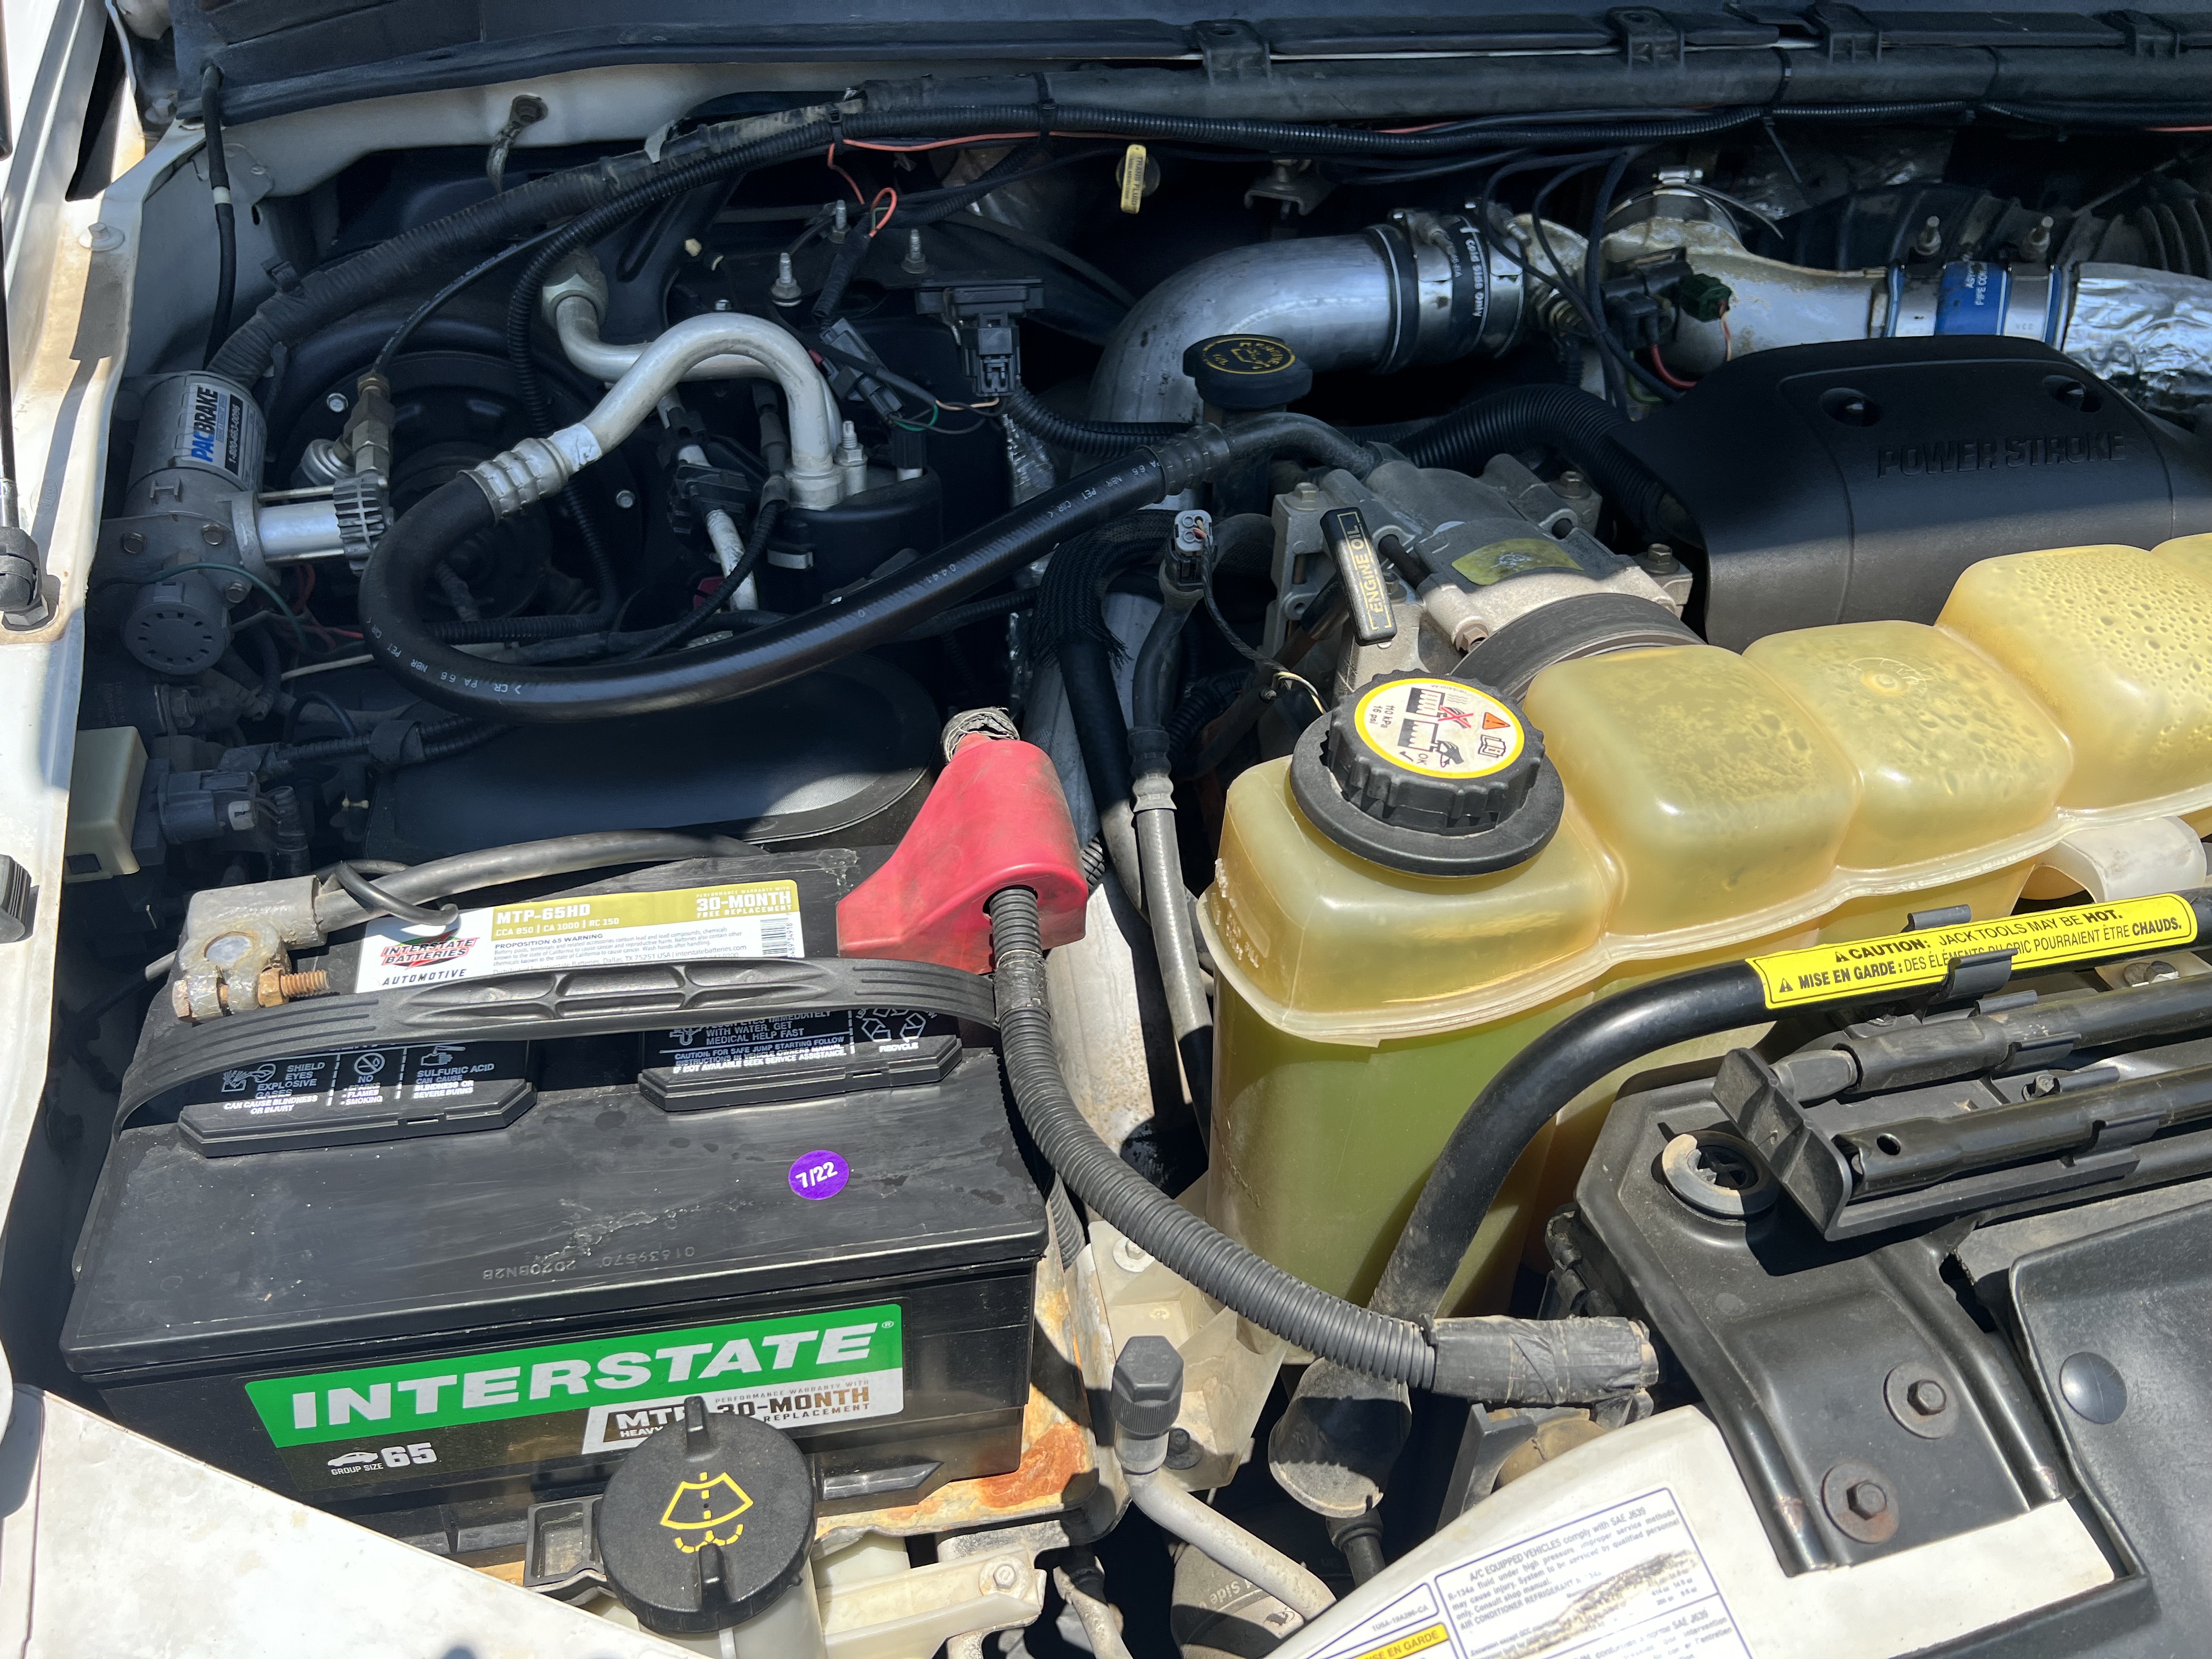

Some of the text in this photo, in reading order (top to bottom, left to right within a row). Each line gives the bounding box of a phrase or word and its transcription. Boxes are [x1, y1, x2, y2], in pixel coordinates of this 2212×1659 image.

[1465, 239, 1484, 317] Cold Side Only
[1213, 354, 1228, 365] OIL
[1256, 343, 1284, 365] ENGINE
[191, 386, 219, 462] PACBRAKE
[1877, 431, 2126, 478] POWER STROKE
[1132, 465, 1146, 476] 66
[1105, 475, 1122, 487] NBR
[1081, 487, 1097, 500] PET
[1347, 525, 1384, 613] ENGINE OIL
[386, 643, 402, 658] PET
[410, 658, 428, 673] NBR
[464, 678, 478, 689] PA
[494, 682, 508, 693] CR
[1369, 714, 1378, 725] psi
[1381, 715, 1393, 728] kPa
[1417, 753, 1429, 765] OK
[696, 891, 791, 912] 30-MONTH
[496, 904, 590, 925] MTP-65HD
[724, 905, 792, 916] REPLACEMENT
[495, 918, 619, 936] CCA 850 CA 1000 RC 150
[1848, 909, 2124, 960] CAUTION: JACK TOOLS MAY BE HOT.
[383, 939, 475, 955] INTERSTATE
[495, 939, 550, 949] PROPOSITION
[564, 933, 603, 943] WARNING
[586, 938, 614, 946] accessories
[385, 948, 467, 964] BATTERIES
[675, 945, 747, 957] interstatebatteries.com
[1798, 971, 1831, 990] MISE
[1833, 967, 1851, 983] EN
[1905, 957, 1927, 973] DES
[2034, 929, 2101, 952] POURRAIENT
[2103, 923, 2130, 940] ÊTRE
[2132, 916, 2182, 936] CHAUDS.
[382, 969, 467, 986] AUTOMOTIVE
[769, 1011, 831, 1023] IMMEDIATELY
[706, 1028, 731, 1037] WITH
[774, 1021, 793, 1030] GET
[706, 1028, 805, 1046] MEDICAL HELP FAST
[731, 1046, 750, 1054] SAFE
[752, 1044, 773, 1053] JUMP
[775, 1040, 812, 1050] STARTING
[814, 1036, 844, 1046] FOLLOW
[879, 1042, 919, 1053] RECYCLE
[287, 1062, 325, 1073] SHIELD
[675, 1056, 731, 1066] INSTRUCTIONS
[682, 1064, 700, 1073] NOT
[701, 1060, 742, 1071] AVAILABLE
[765, 1055, 797, 1064] SERVICE
[798, 1050, 847, 1060] ASSISTANCE.
[285, 1071, 313, 1081] EYES
[417, 1063, 494, 1078] SULFURIC ACID
[257, 1079, 317, 1091] EXPLOSIVE
[413, 1087, 473, 1099] SEVERE BURNS
[414, 1081, 459, 1092] BLINDNESS
[255, 1088, 292, 1099] GASES
[345, 1096, 383, 1105] SMOKING
[347, 1089, 379, 1098] FLAMES
[224, 1094, 318, 1110] CAN CAUSE BLINDNESS
[264, 1104, 295, 1113] INJURY
[795, 1161, 839, 1189] 7/22
[291, 1322, 878, 1429] INTERSTATE
[715, 1379, 870, 1403] PERFORMANCE WARRANTY WITH
[764, 1402, 871, 1423] REPLACEMENT
[381, 1441, 437, 1469] 65
[331, 1462, 384, 1476] GROUP SIZE
[1470, 1506, 1646, 1582] A/C EQUIPPED VEHICLES comply with SAE J639
[1447, 1508, 1676, 1601] R-134a fluid under high service methods
[1452, 1518, 1680, 1612] may cause System serviced qualified personnel
[1209, 1580, 1240, 1604] Side
[1460, 1619, 1474, 1631] AIR
[1474, 1599, 1523, 1625] CONDITIONER
[1524, 1582, 1574, 1605] REFRIGERANT
[1474, 1590, 1522, 1613] Consult shop
[1387, 1645, 1401, 1657] EN
[1403, 1630, 1440, 1651] GARDE
